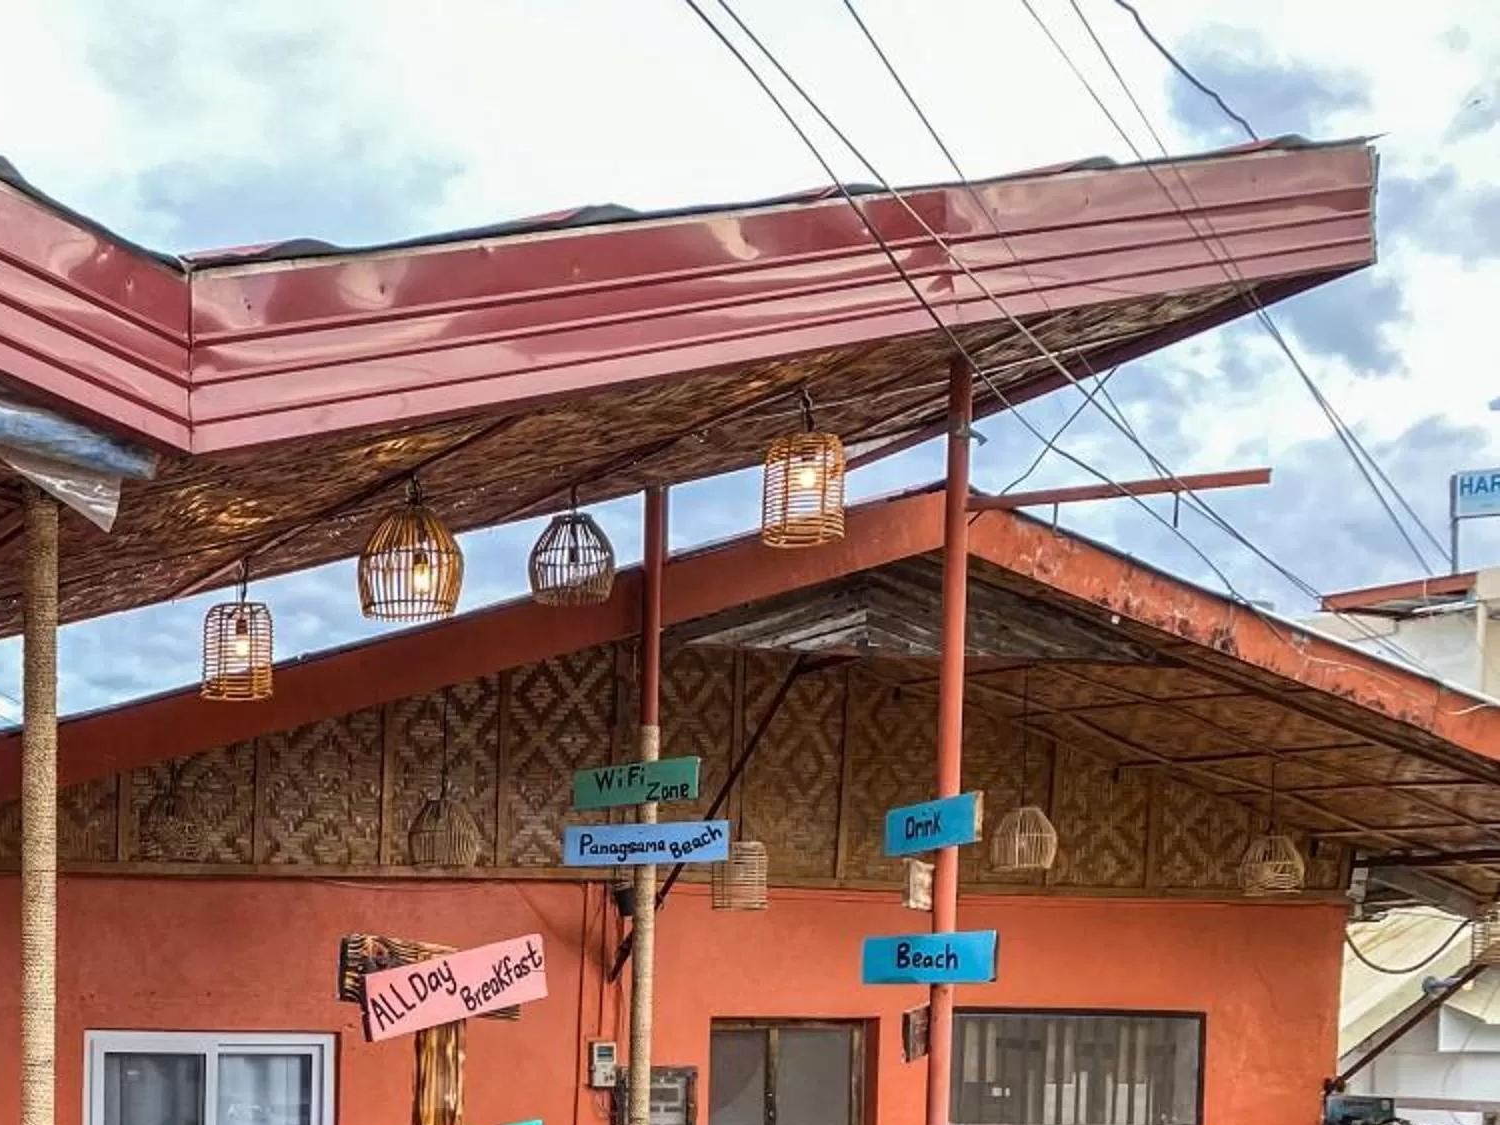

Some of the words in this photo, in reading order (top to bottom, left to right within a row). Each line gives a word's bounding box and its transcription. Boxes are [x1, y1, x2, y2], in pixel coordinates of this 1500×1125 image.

[645, 781, 690, 800] Zone
[896, 942, 959, 970] Beach
[408, 959, 458, 1003] Day
